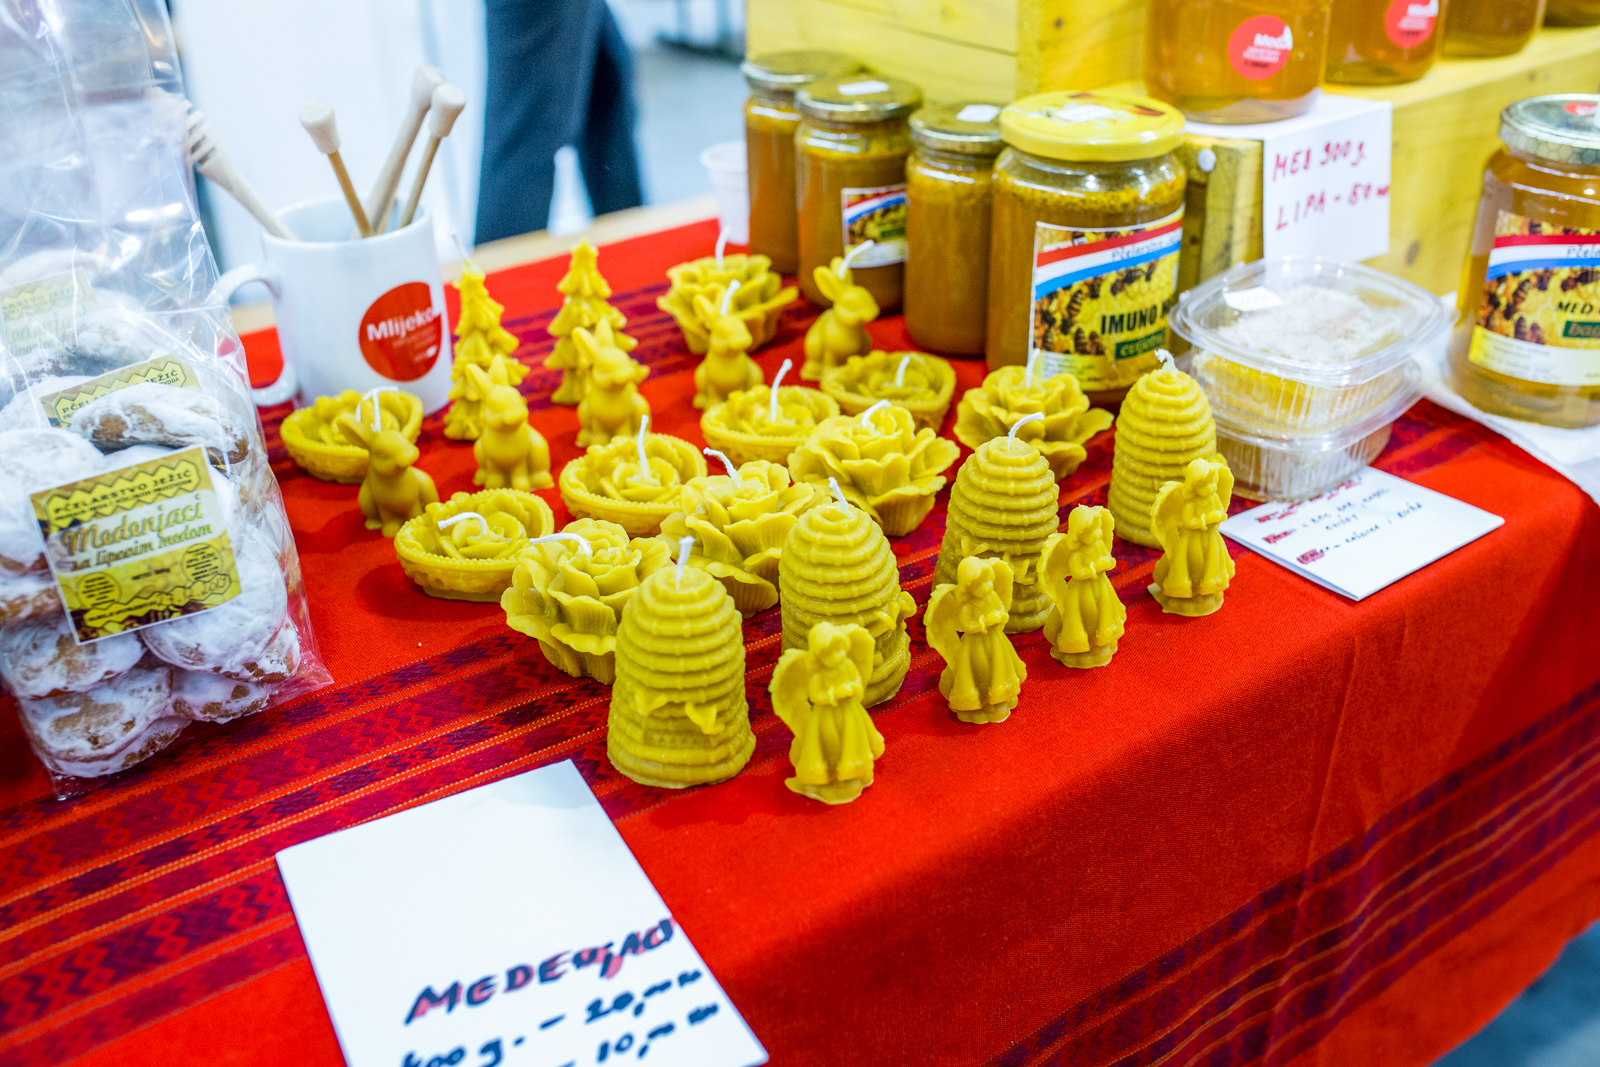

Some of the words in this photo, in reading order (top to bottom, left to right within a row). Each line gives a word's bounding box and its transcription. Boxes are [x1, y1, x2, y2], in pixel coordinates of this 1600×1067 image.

[1276, 190, 1325, 231] LIPA
[366, 306, 435, 342] Mlijeko
[1101, 304, 1157, 335] IMUNO
[61, 493, 203, 556] Medenjaci
[159, 524, 213, 548] medom
